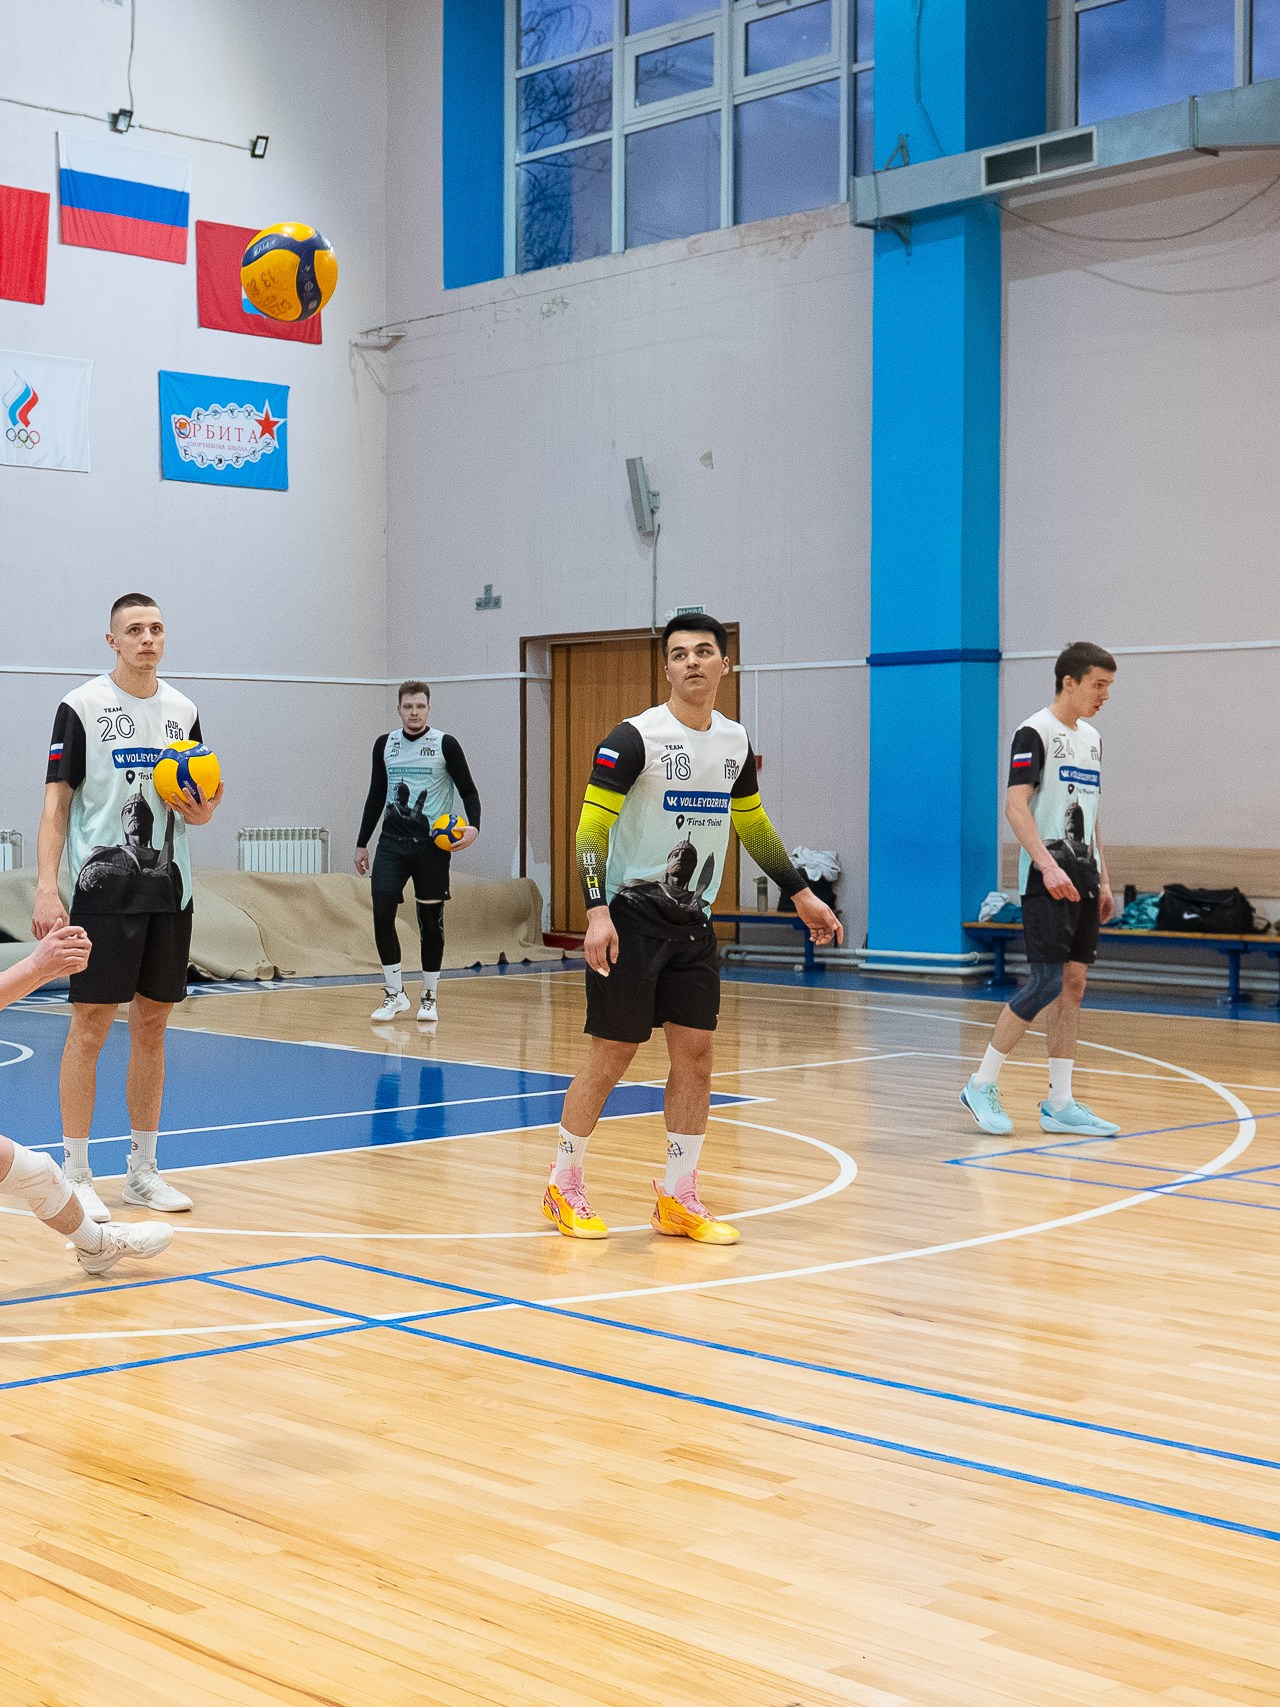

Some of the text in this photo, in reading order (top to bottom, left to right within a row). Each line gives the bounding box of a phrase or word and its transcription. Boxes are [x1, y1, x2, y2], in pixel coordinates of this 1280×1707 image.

[175, 417, 259, 443] ОРБИТА
[97, 714, 135, 742] 20
[114, 754, 125, 763] VK
[661, 753, 691, 780] 18
[666, 796, 677, 806] VK
[687, 817, 722, 827] First Point
